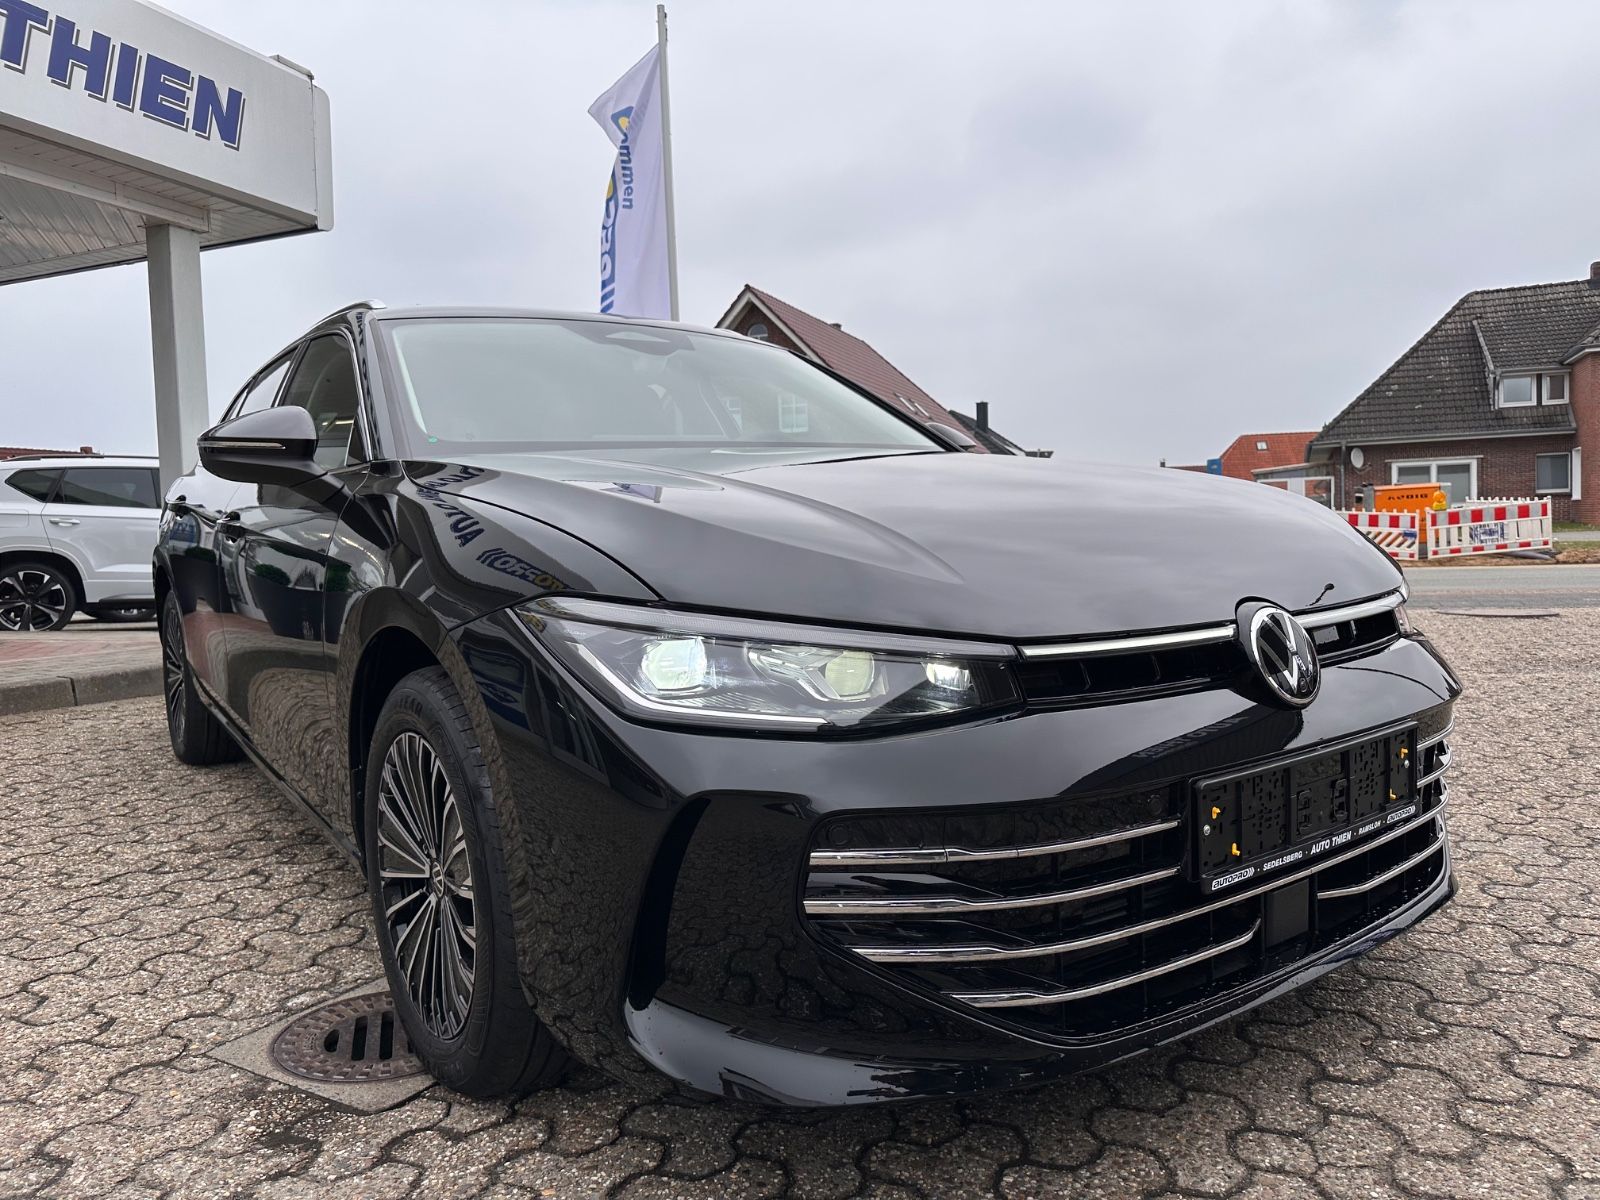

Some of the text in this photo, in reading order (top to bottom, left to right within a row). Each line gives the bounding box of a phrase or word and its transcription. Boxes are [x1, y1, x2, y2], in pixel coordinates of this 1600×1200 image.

[0, 0, 246, 151] THIEN
[1262, 850, 1303, 872] SEDELSBERG
[1310, 839, 1331, 855] AUTO
[1332, 830, 1352, 847] THIEN
